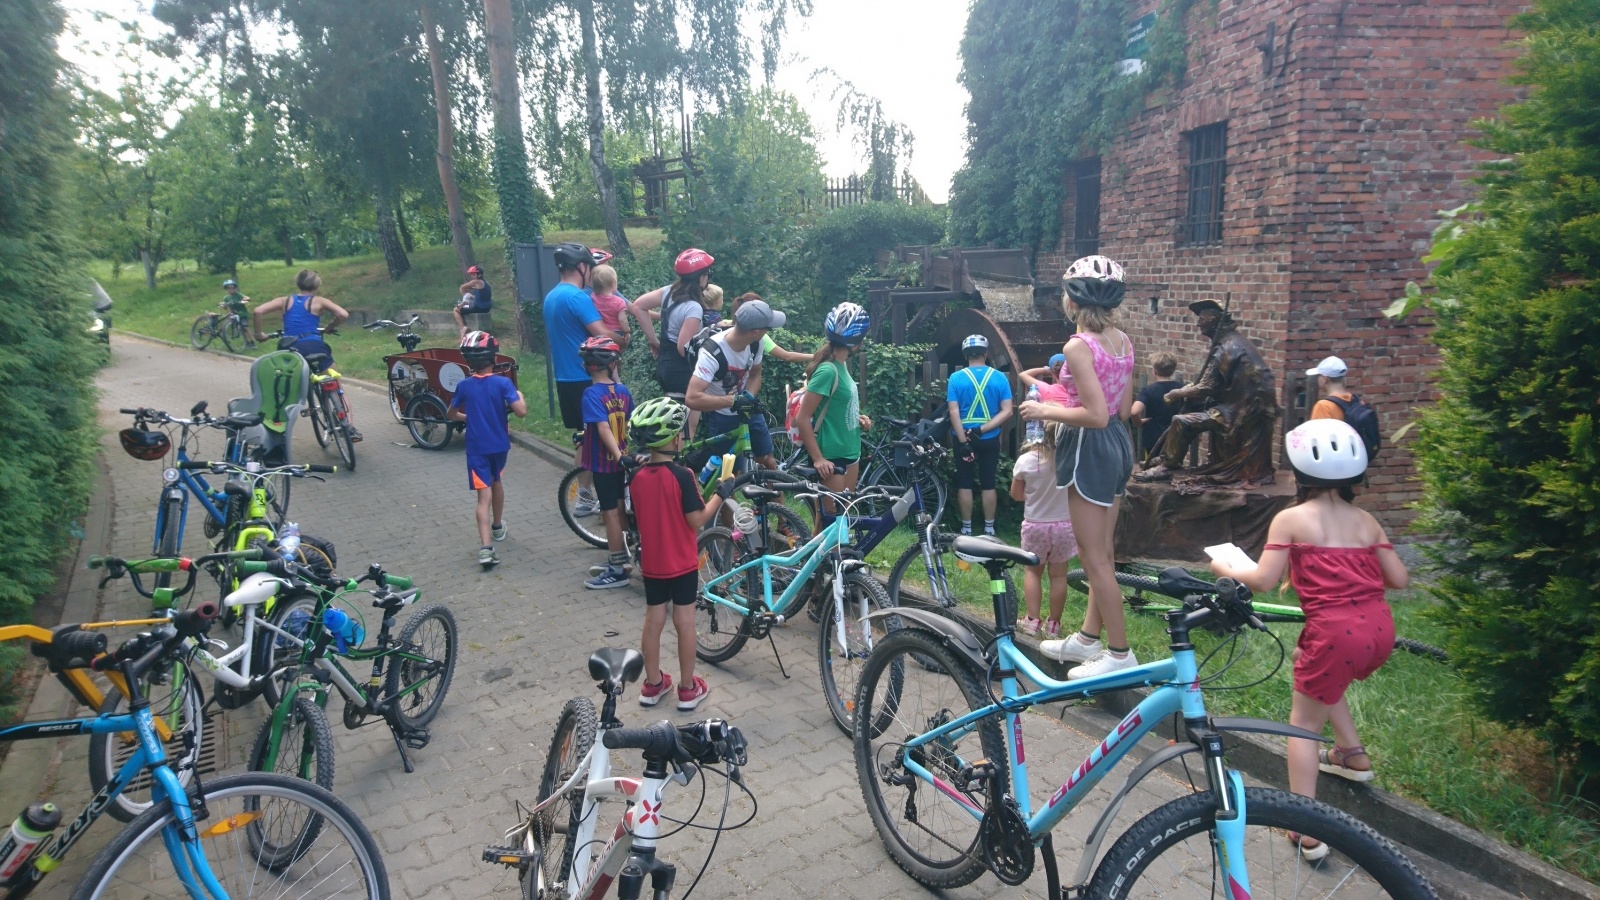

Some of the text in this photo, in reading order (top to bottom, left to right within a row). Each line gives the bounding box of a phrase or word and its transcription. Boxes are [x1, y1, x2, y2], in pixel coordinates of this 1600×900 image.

[38, 723, 78, 732] RESULT
[1048, 708, 1143, 809] BULLS
[1125, 847, 1146, 871] OF
[1149, 817, 1202, 847] PACE
